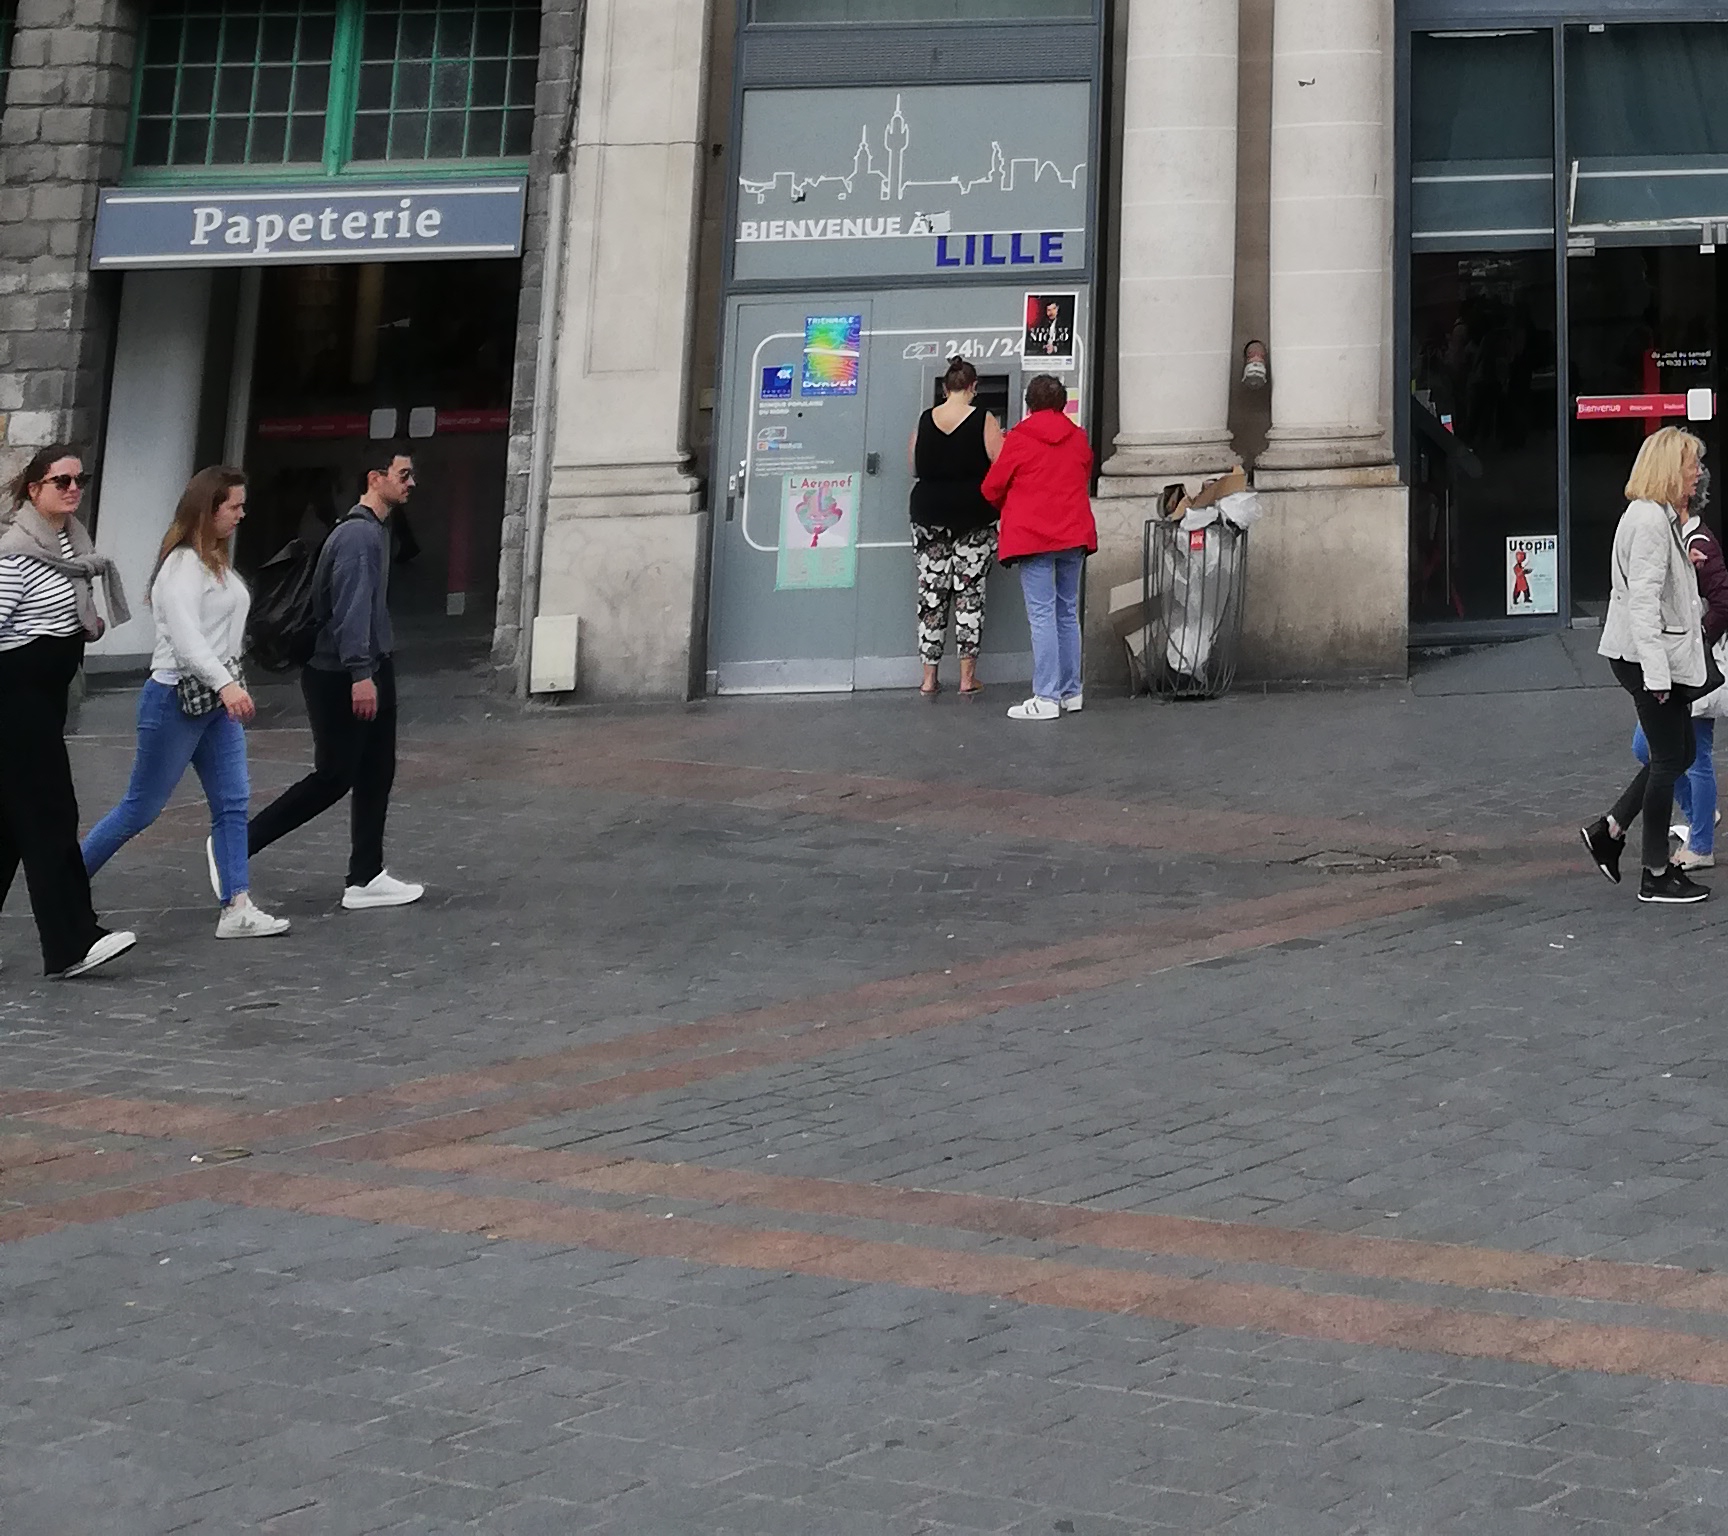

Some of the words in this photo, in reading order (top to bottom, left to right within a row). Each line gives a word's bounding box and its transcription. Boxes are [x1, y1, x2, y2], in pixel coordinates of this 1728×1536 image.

[189, 198, 442, 254] Papeterie
[740, 216, 901, 241] BIENVENUE
[936, 231, 1065, 267] LILLE
[1577, 403, 1621, 414] Bienvenue
[1508, 539, 1555, 555] Utopia
